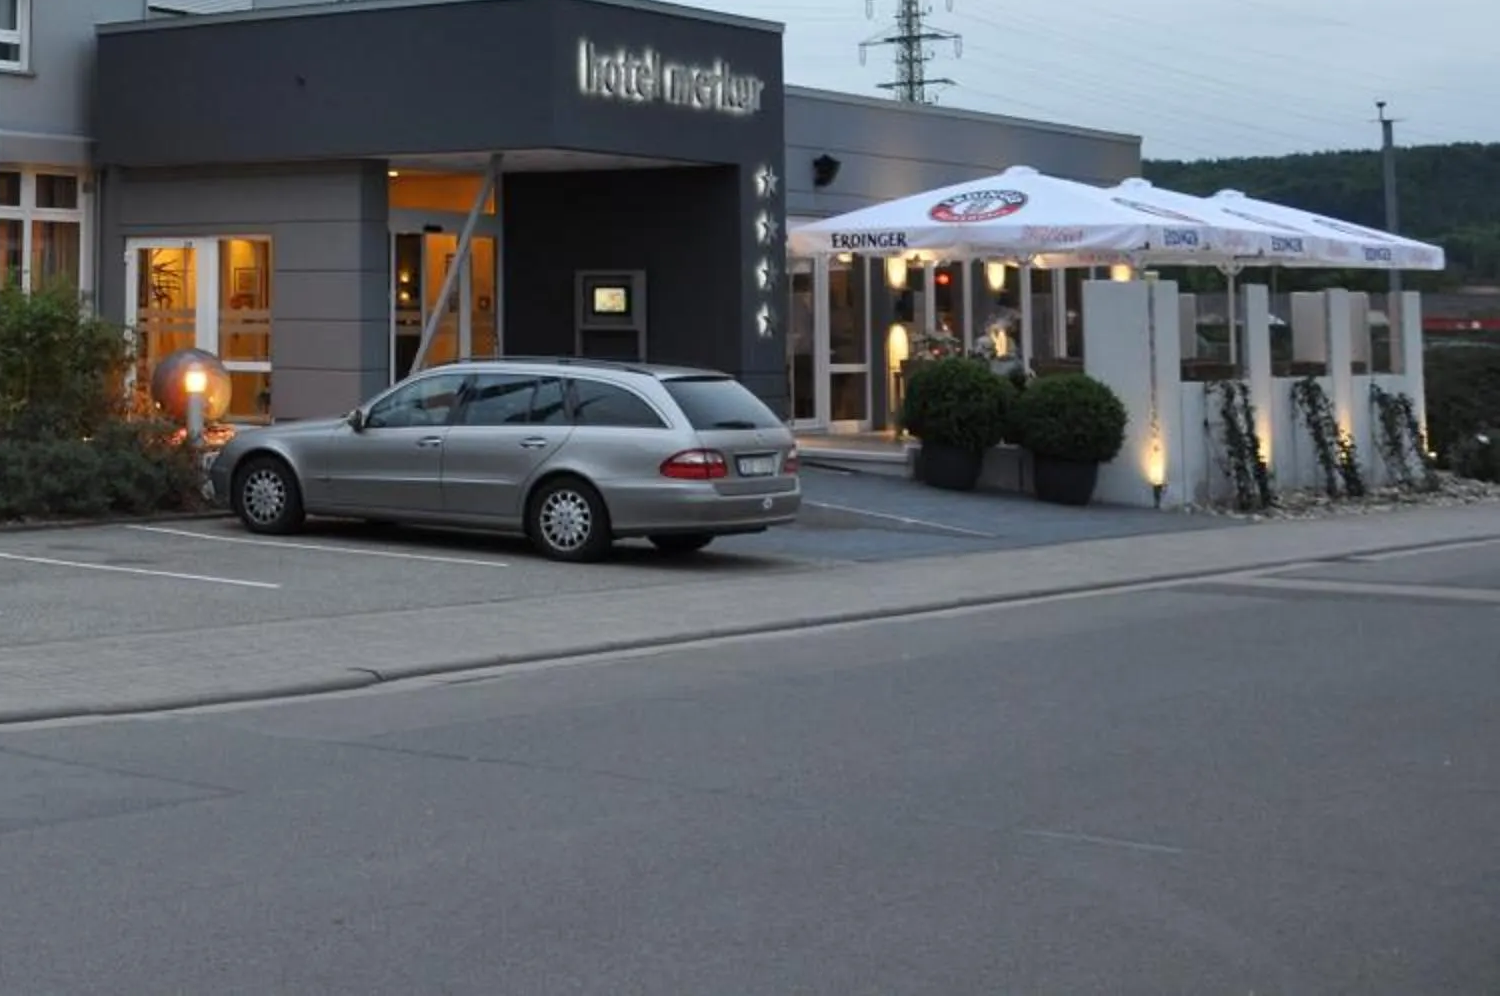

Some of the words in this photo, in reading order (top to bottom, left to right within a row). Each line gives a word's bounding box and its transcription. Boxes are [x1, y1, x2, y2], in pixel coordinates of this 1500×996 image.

[579, 36, 660, 101] hotel
[662, 58, 764, 114] merkur
[831, 232, 908, 249] ERDINGER
